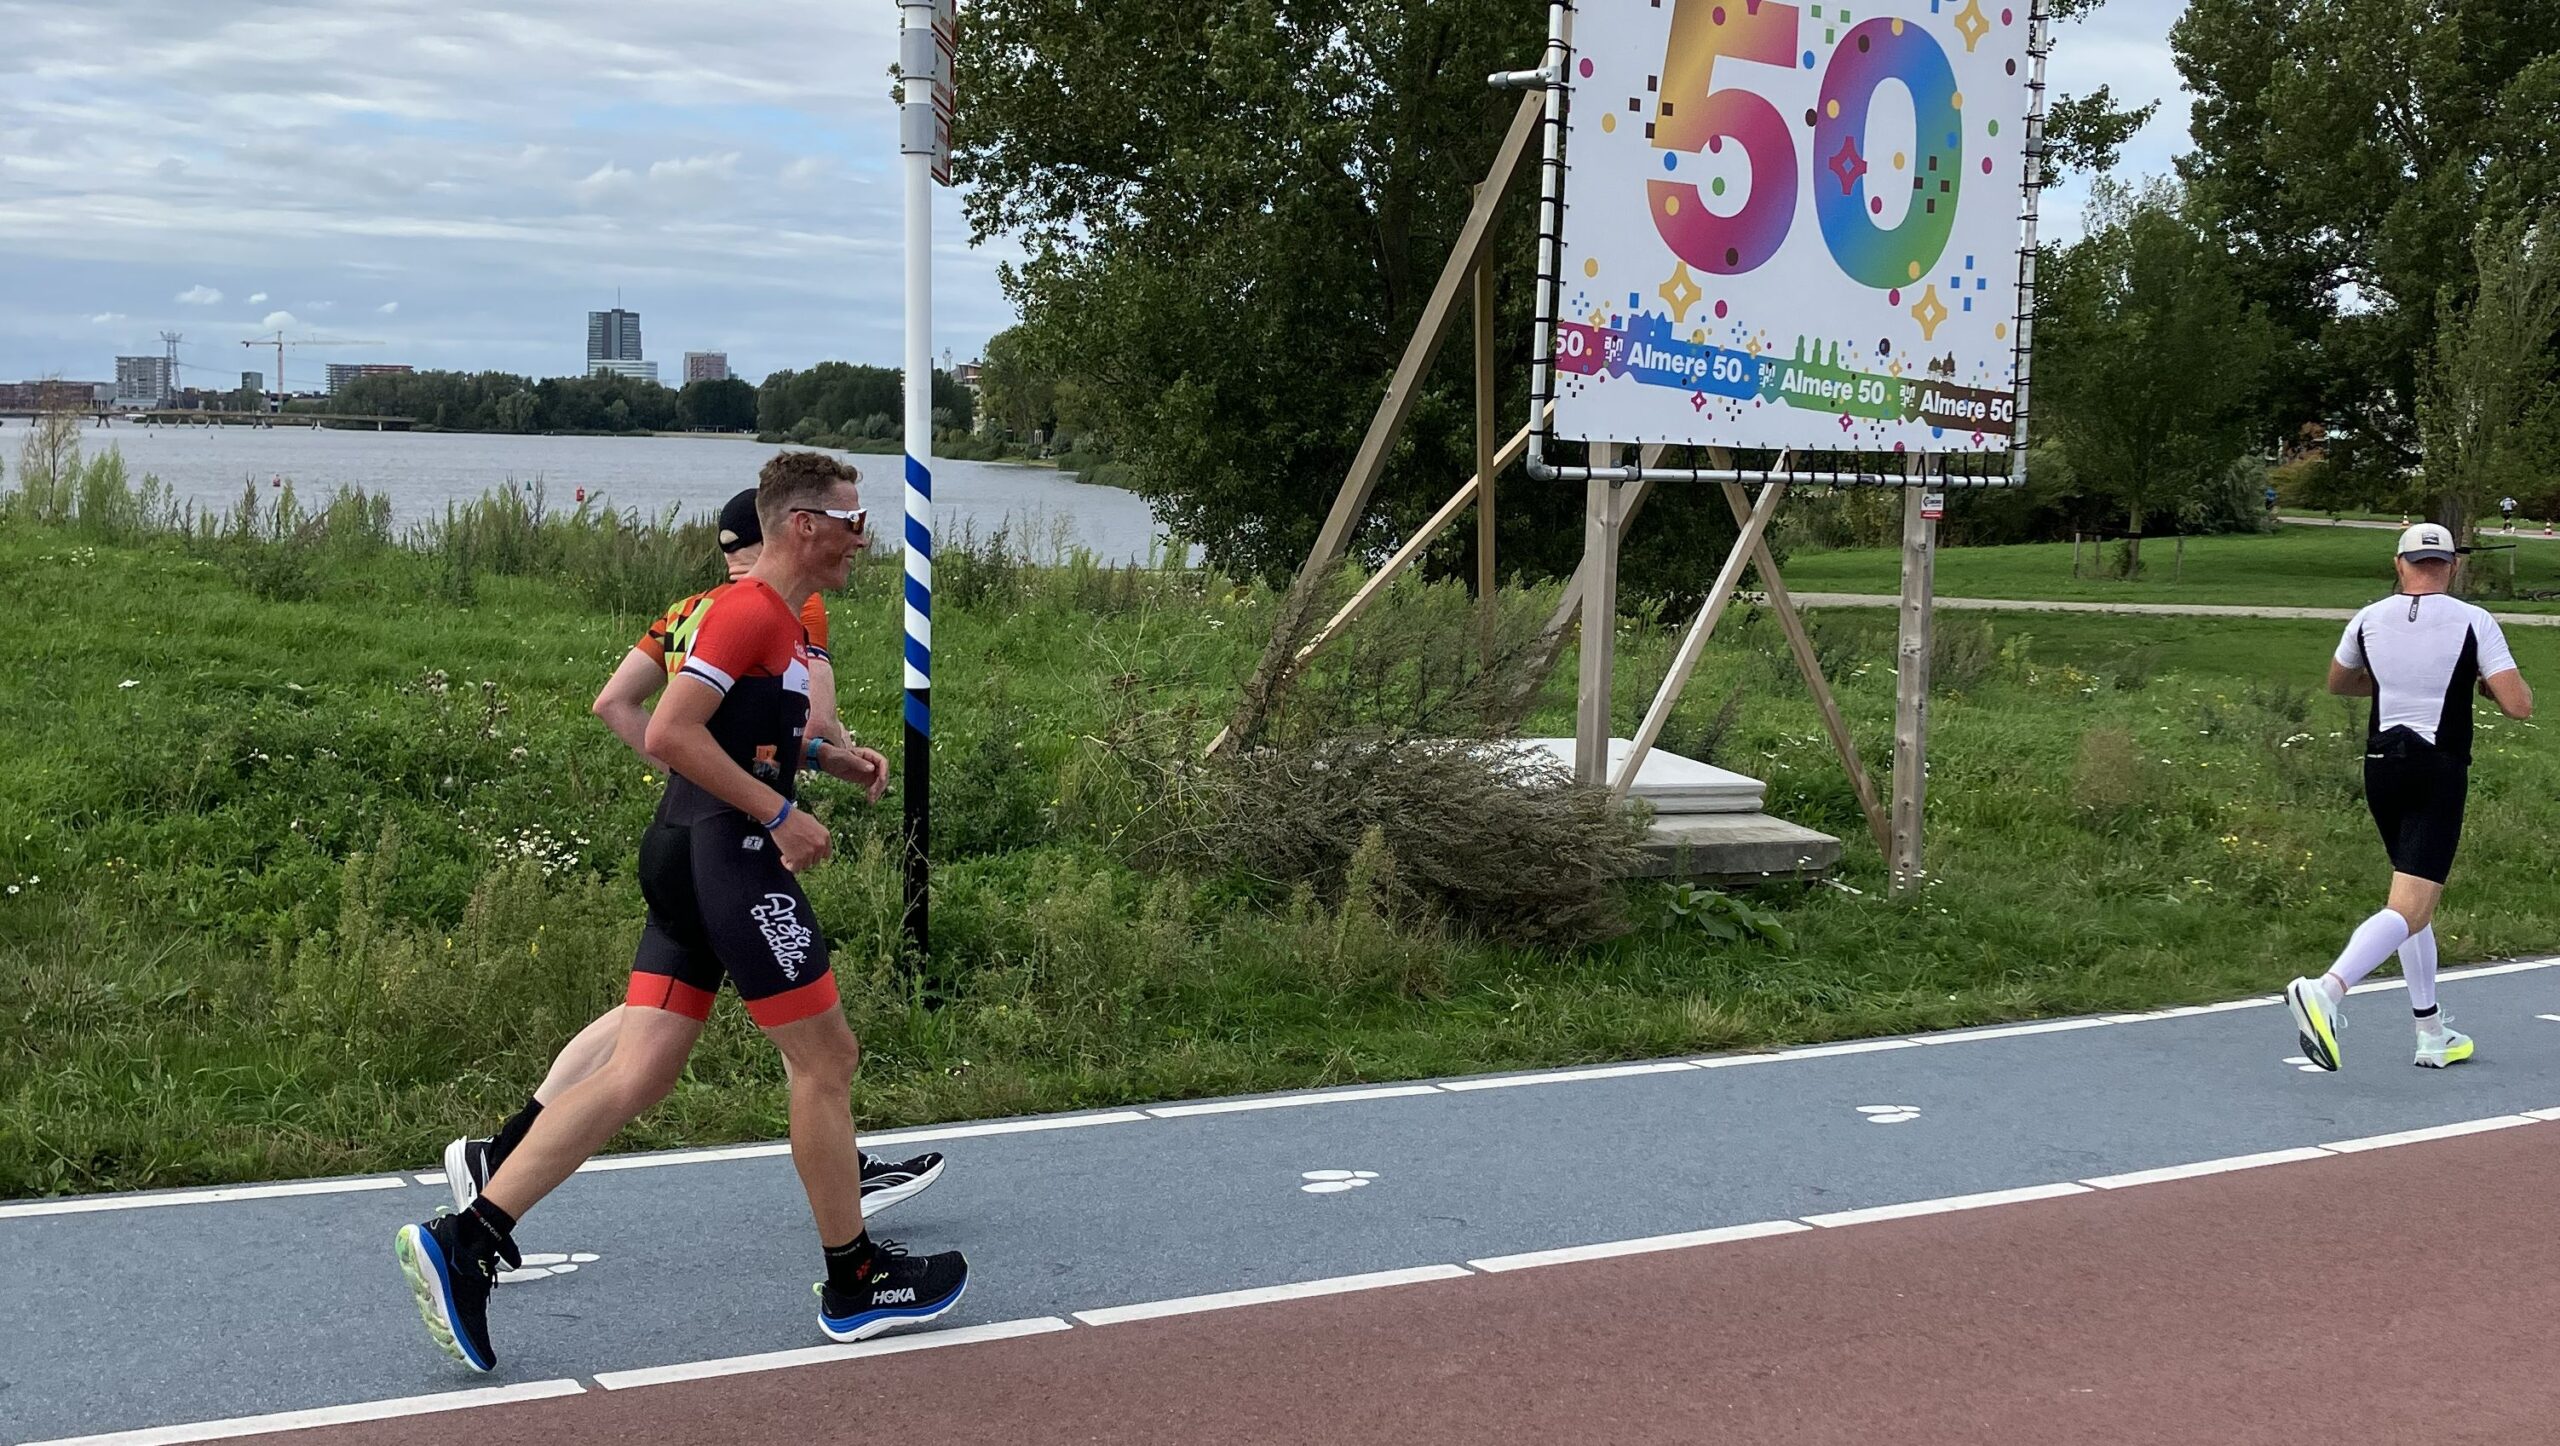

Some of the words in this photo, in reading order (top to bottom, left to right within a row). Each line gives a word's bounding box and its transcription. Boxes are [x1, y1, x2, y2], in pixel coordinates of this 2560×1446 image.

[1646, 0, 1963, 290] 50
[1556, 328, 1585, 358] 50
[1626, 342, 1708, 378] Almere
[1712, 355, 1743, 384] 50
[1780, 367, 1854, 401] Almere
[1857, 379, 1885, 405] 50
[1919, 389, 1986, 420] Almere
[1989, 398, 2013, 423] 50
[871, 1287, 917, 1305] HOKA
